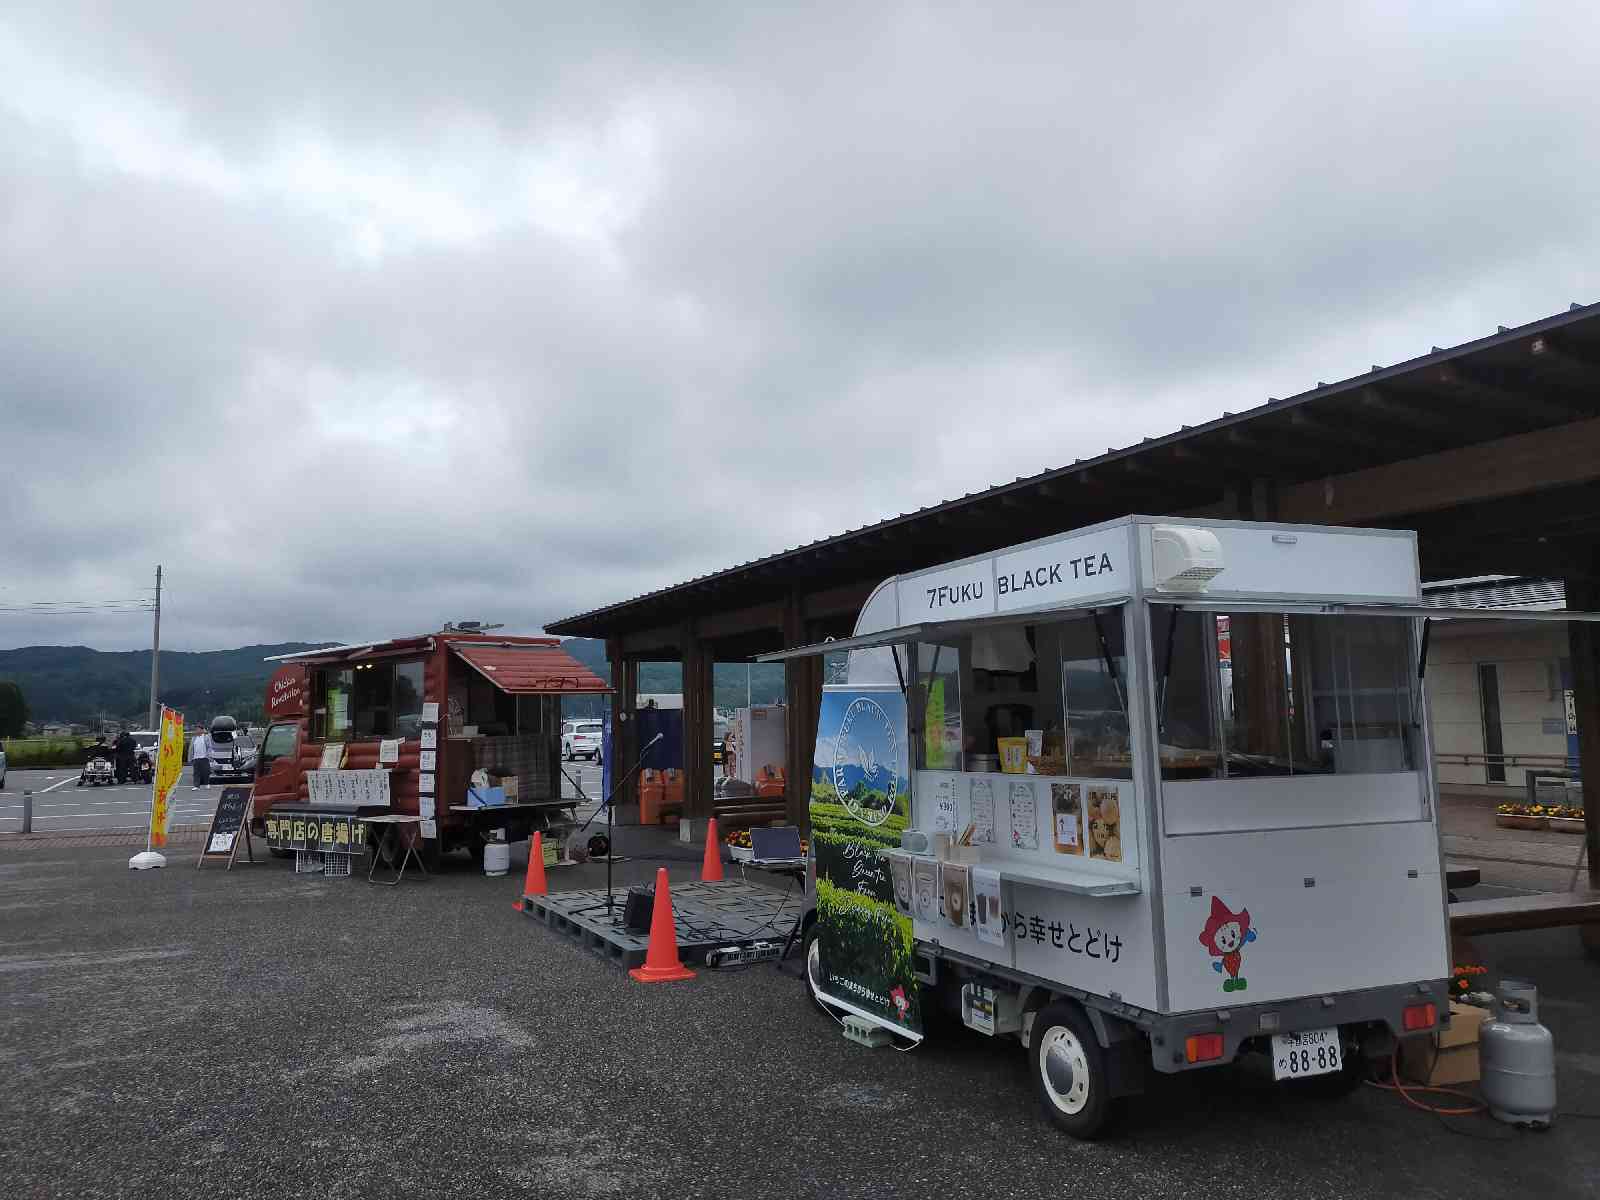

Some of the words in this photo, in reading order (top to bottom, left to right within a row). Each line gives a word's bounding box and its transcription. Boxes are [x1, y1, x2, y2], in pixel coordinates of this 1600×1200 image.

[926, 581, 984, 609] 7FUKU
[997, 563, 1063, 595] BLACK
[1069, 552, 1113, 579] TEA
[265, 818, 365, 845] 専門店の唐揚げ
[1289, 1045, 1338, 1074] 88-88
